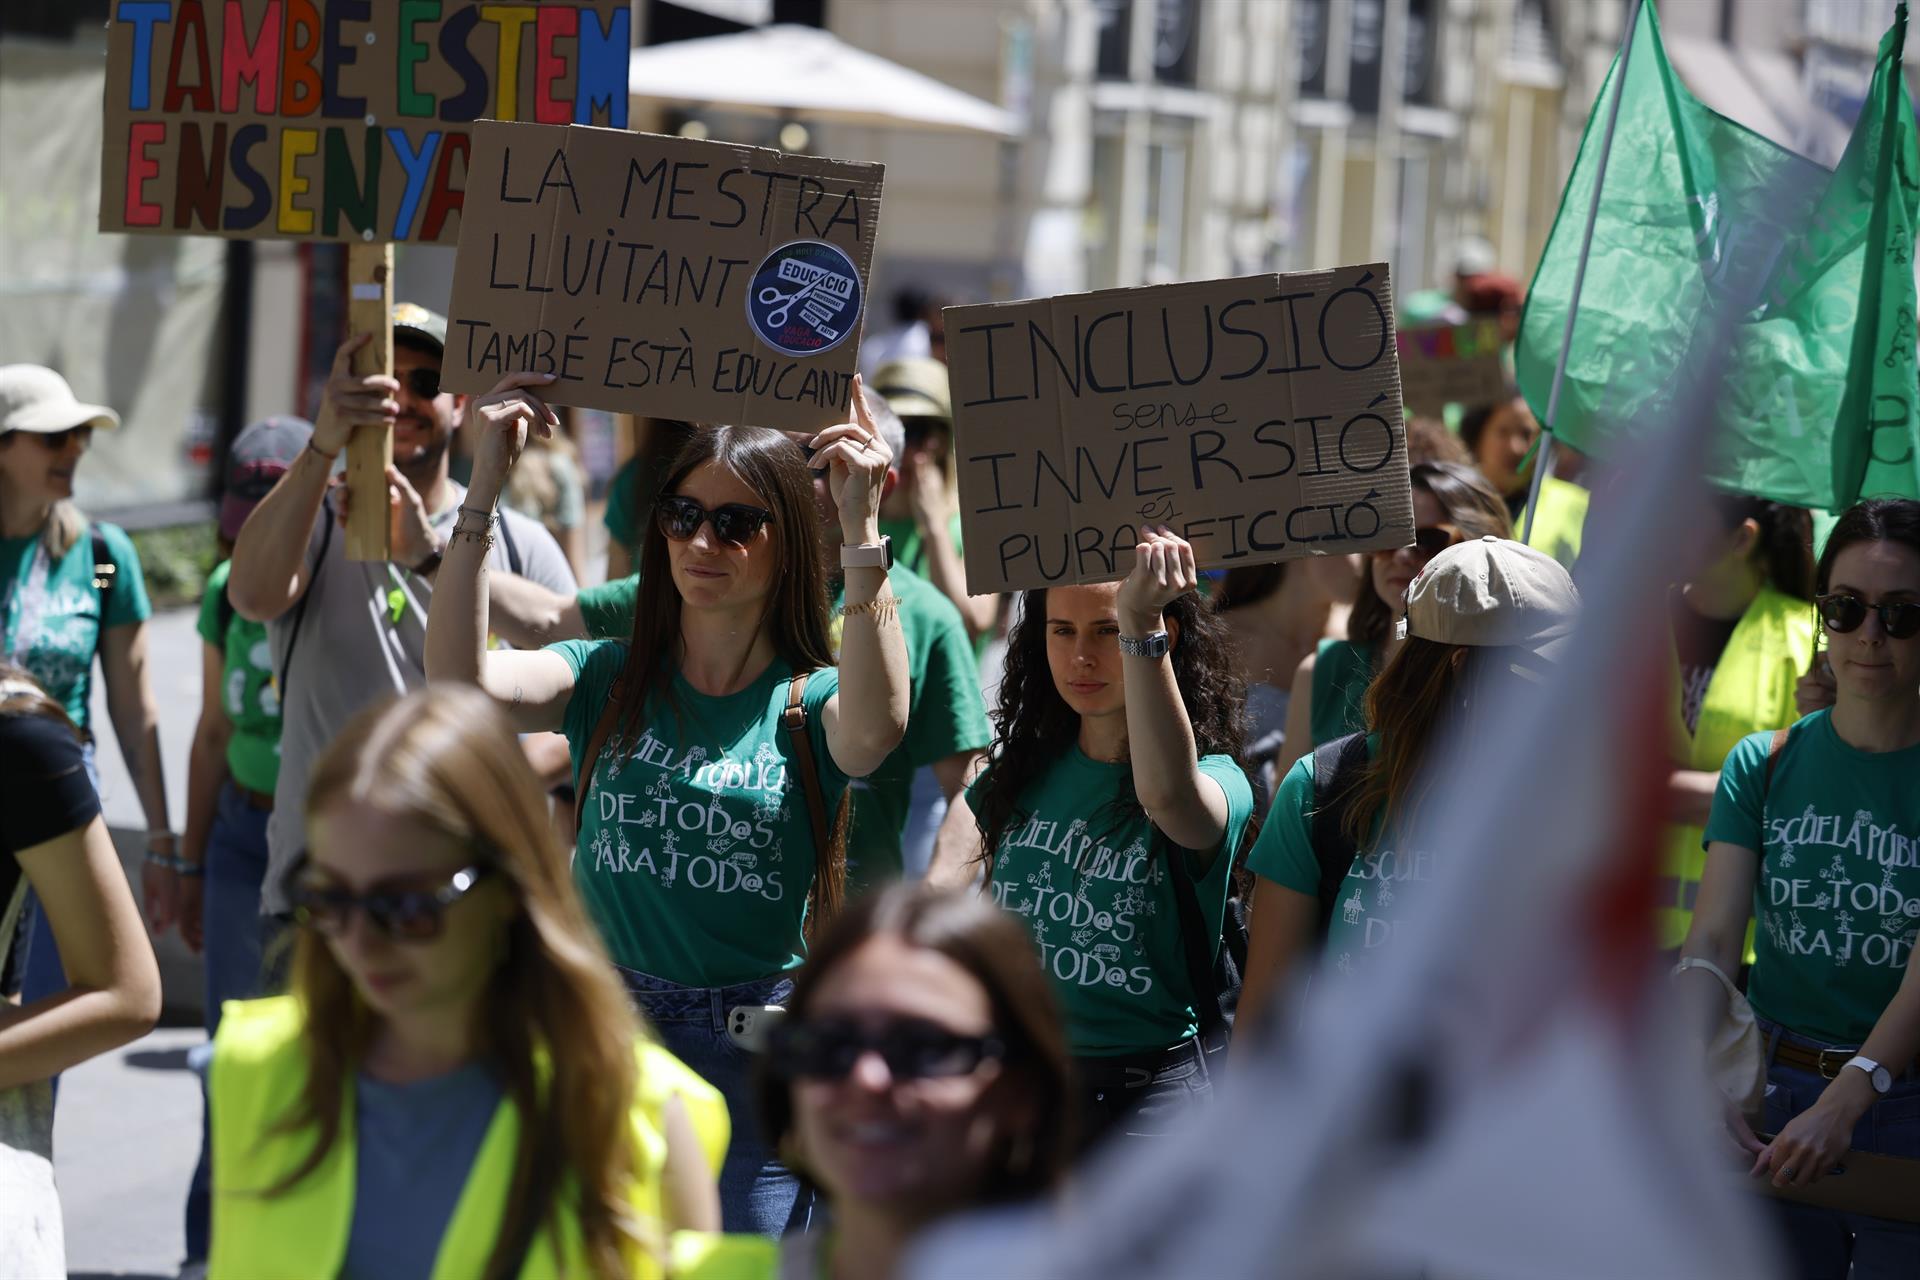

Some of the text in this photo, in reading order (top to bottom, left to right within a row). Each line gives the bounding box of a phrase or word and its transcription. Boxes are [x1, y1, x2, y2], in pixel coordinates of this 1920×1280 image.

[397, 0, 631, 129] ESTEM
[123, 121, 471, 241] ENSENYA
[500, 146, 861, 242] LA MESTRA
[782, 262, 848, 294] EDUCACIÓ
[456, 317, 856, 413] TAMBÉ ESTÀ EDUCANT
[960, 270, 1387, 406] INCLUSIÓ
[969, 392, 1394, 513] INVERSIÓ
[1113, 402, 1237, 431] sense
[999, 488, 1381, 582] PURA FICCIÓ
[1136, 493, 1183, 520] és
[600, 791, 774, 848] DE TOD@S
[662, 849, 783, 901] TOD@S
[1770, 877, 1818, 908] DE
[1031, 886, 1136, 942] TOD@S
